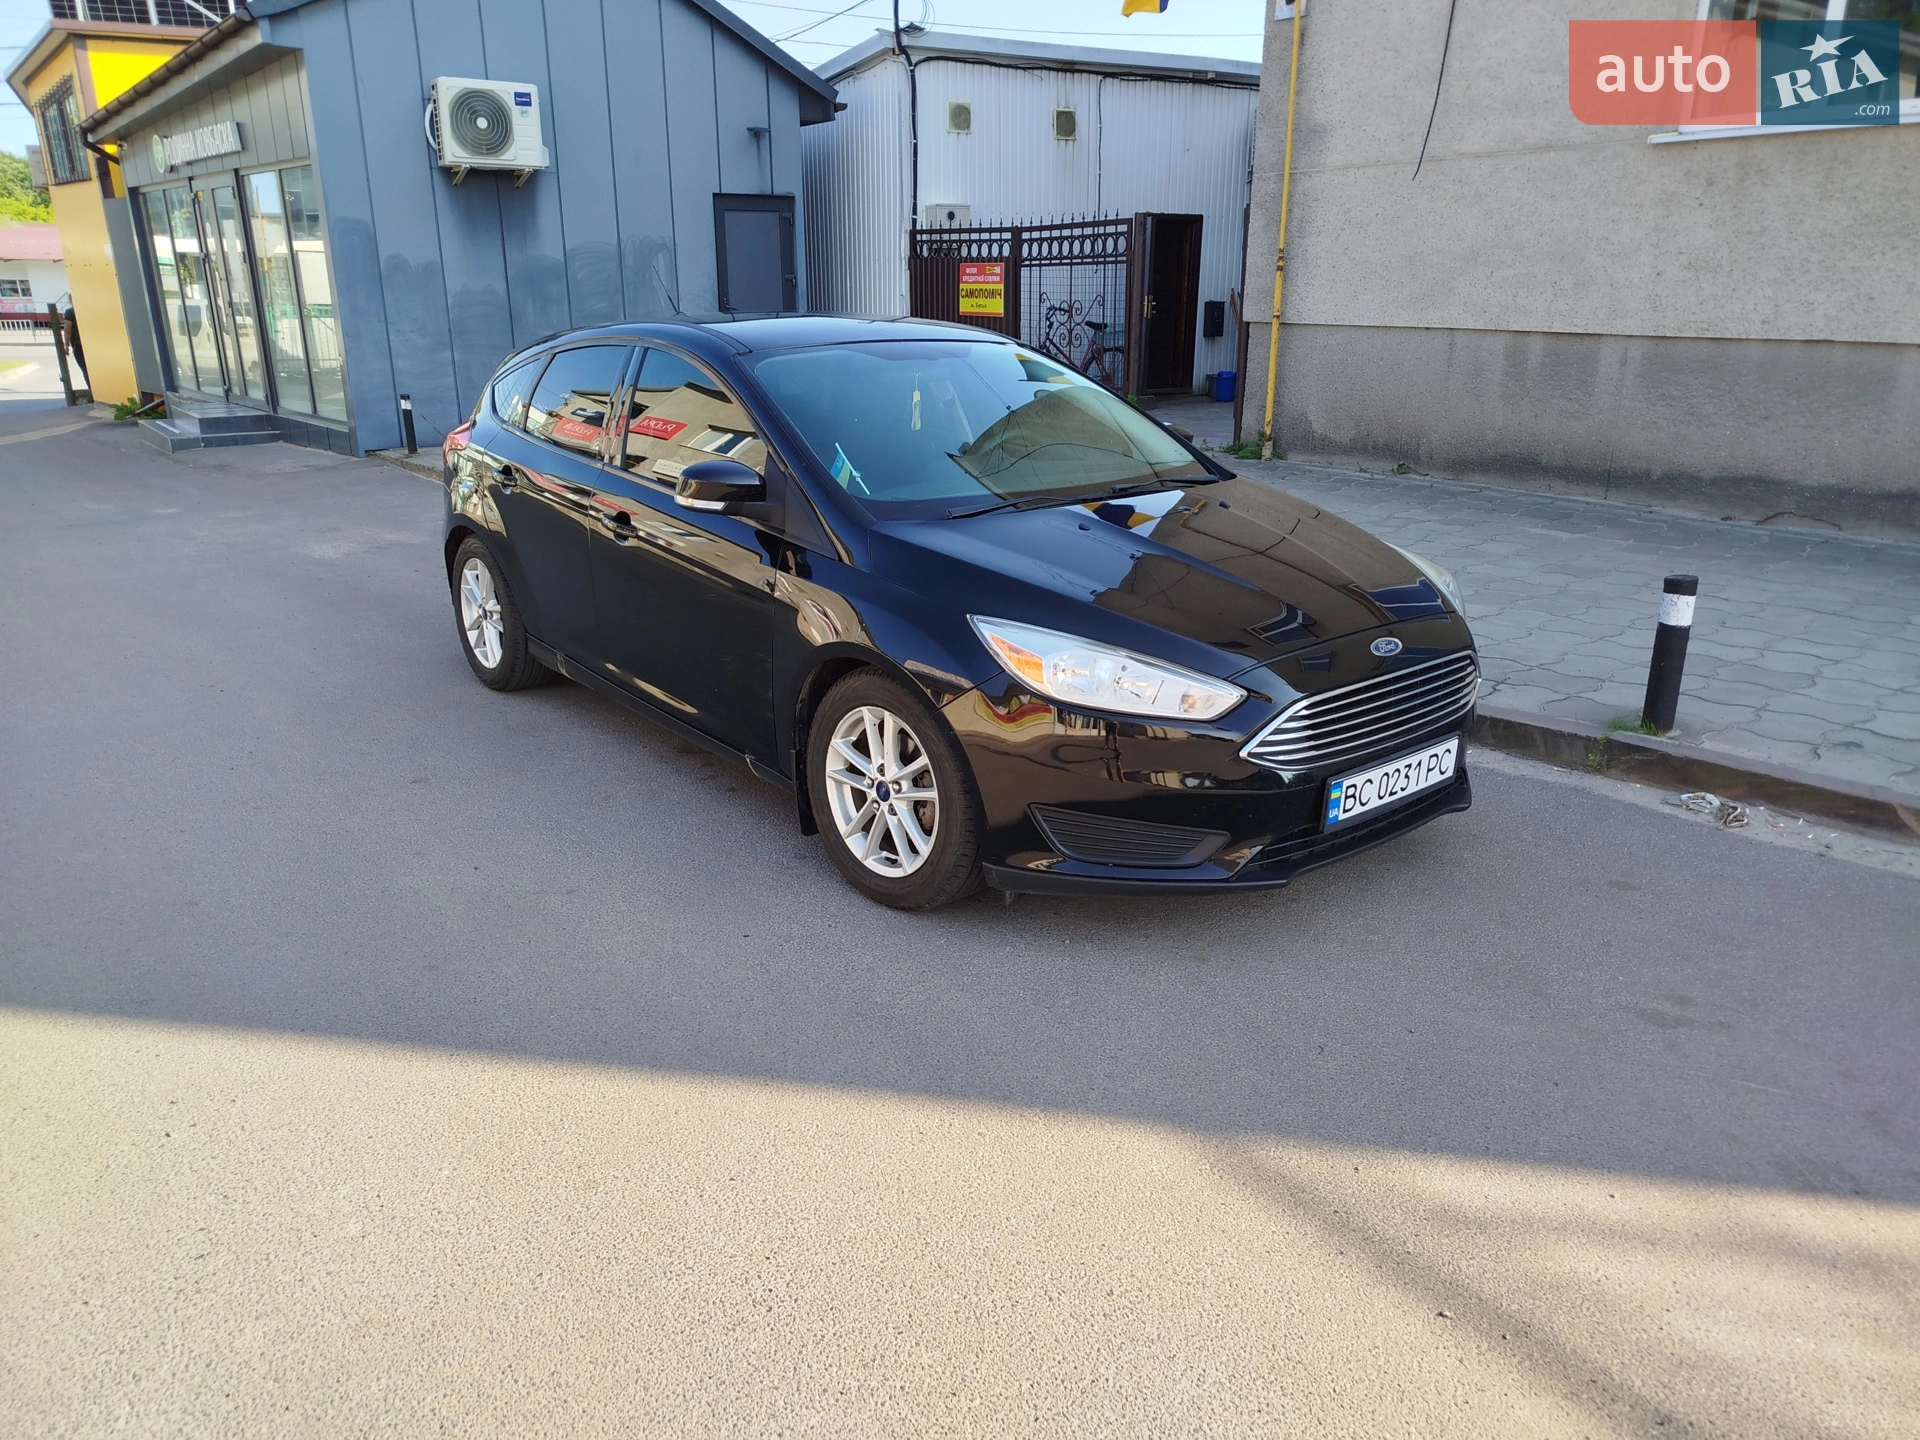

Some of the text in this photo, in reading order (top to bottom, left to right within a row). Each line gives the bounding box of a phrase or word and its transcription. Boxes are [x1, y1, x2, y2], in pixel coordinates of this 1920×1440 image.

[163, 121, 236, 166] РОДИННА КОВБАСКА
[960, 287, 1002, 299] САМОПОМІЧ
[1378, 640, 1397, 653] Ford
[1342, 748, 1452, 815] BC 0231 PC
[1329, 807, 1339, 818] UA
